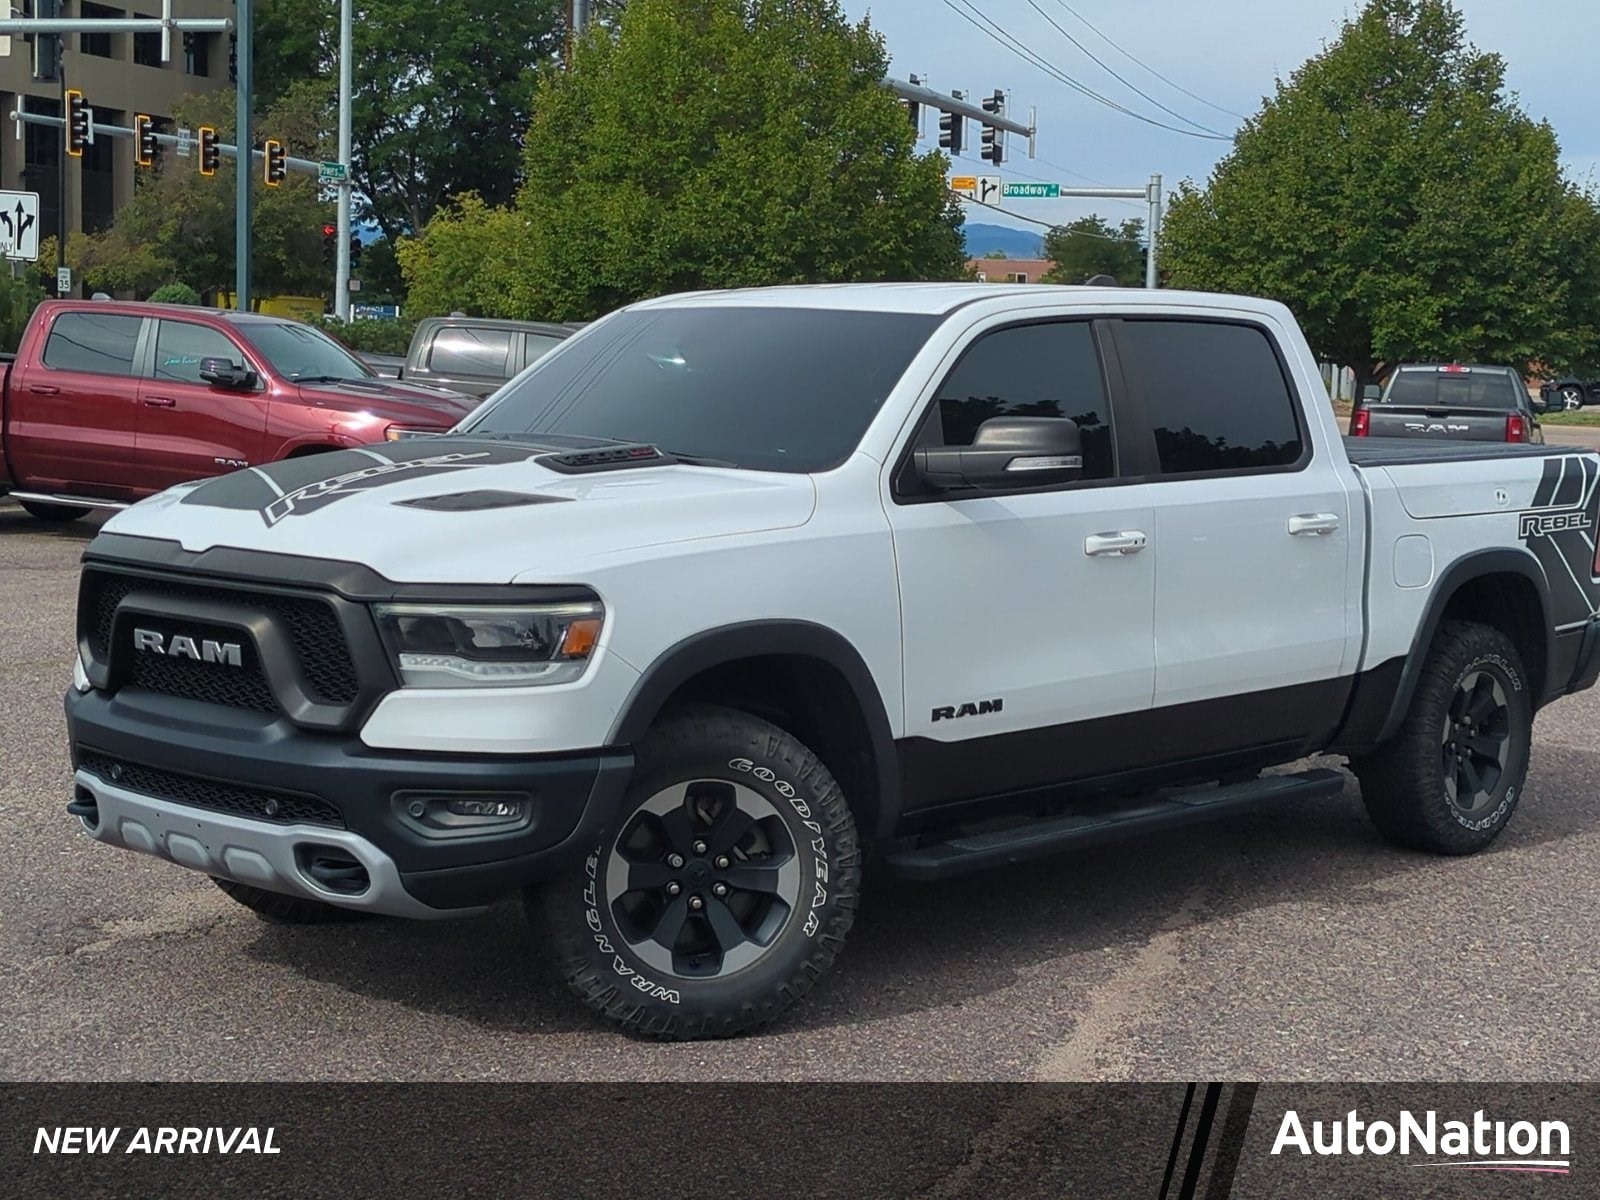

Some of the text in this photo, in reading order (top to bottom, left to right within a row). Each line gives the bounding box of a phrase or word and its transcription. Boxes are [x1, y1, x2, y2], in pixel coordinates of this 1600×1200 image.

[1003, 184, 1048, 198] Broadway
[0, 241, 13, 253] NLY
[59, 280, 69, 289] 35
[1404, 423, 1470, 434] RAM
[214, 457, 249, 467] RAM
[1520, 512, 1592, 537] REBEL
[134, 628, 242, 666] RAM
[931, 698, 1003, 722] RAM
[728, 758, 829, 937] GOODYEAR
